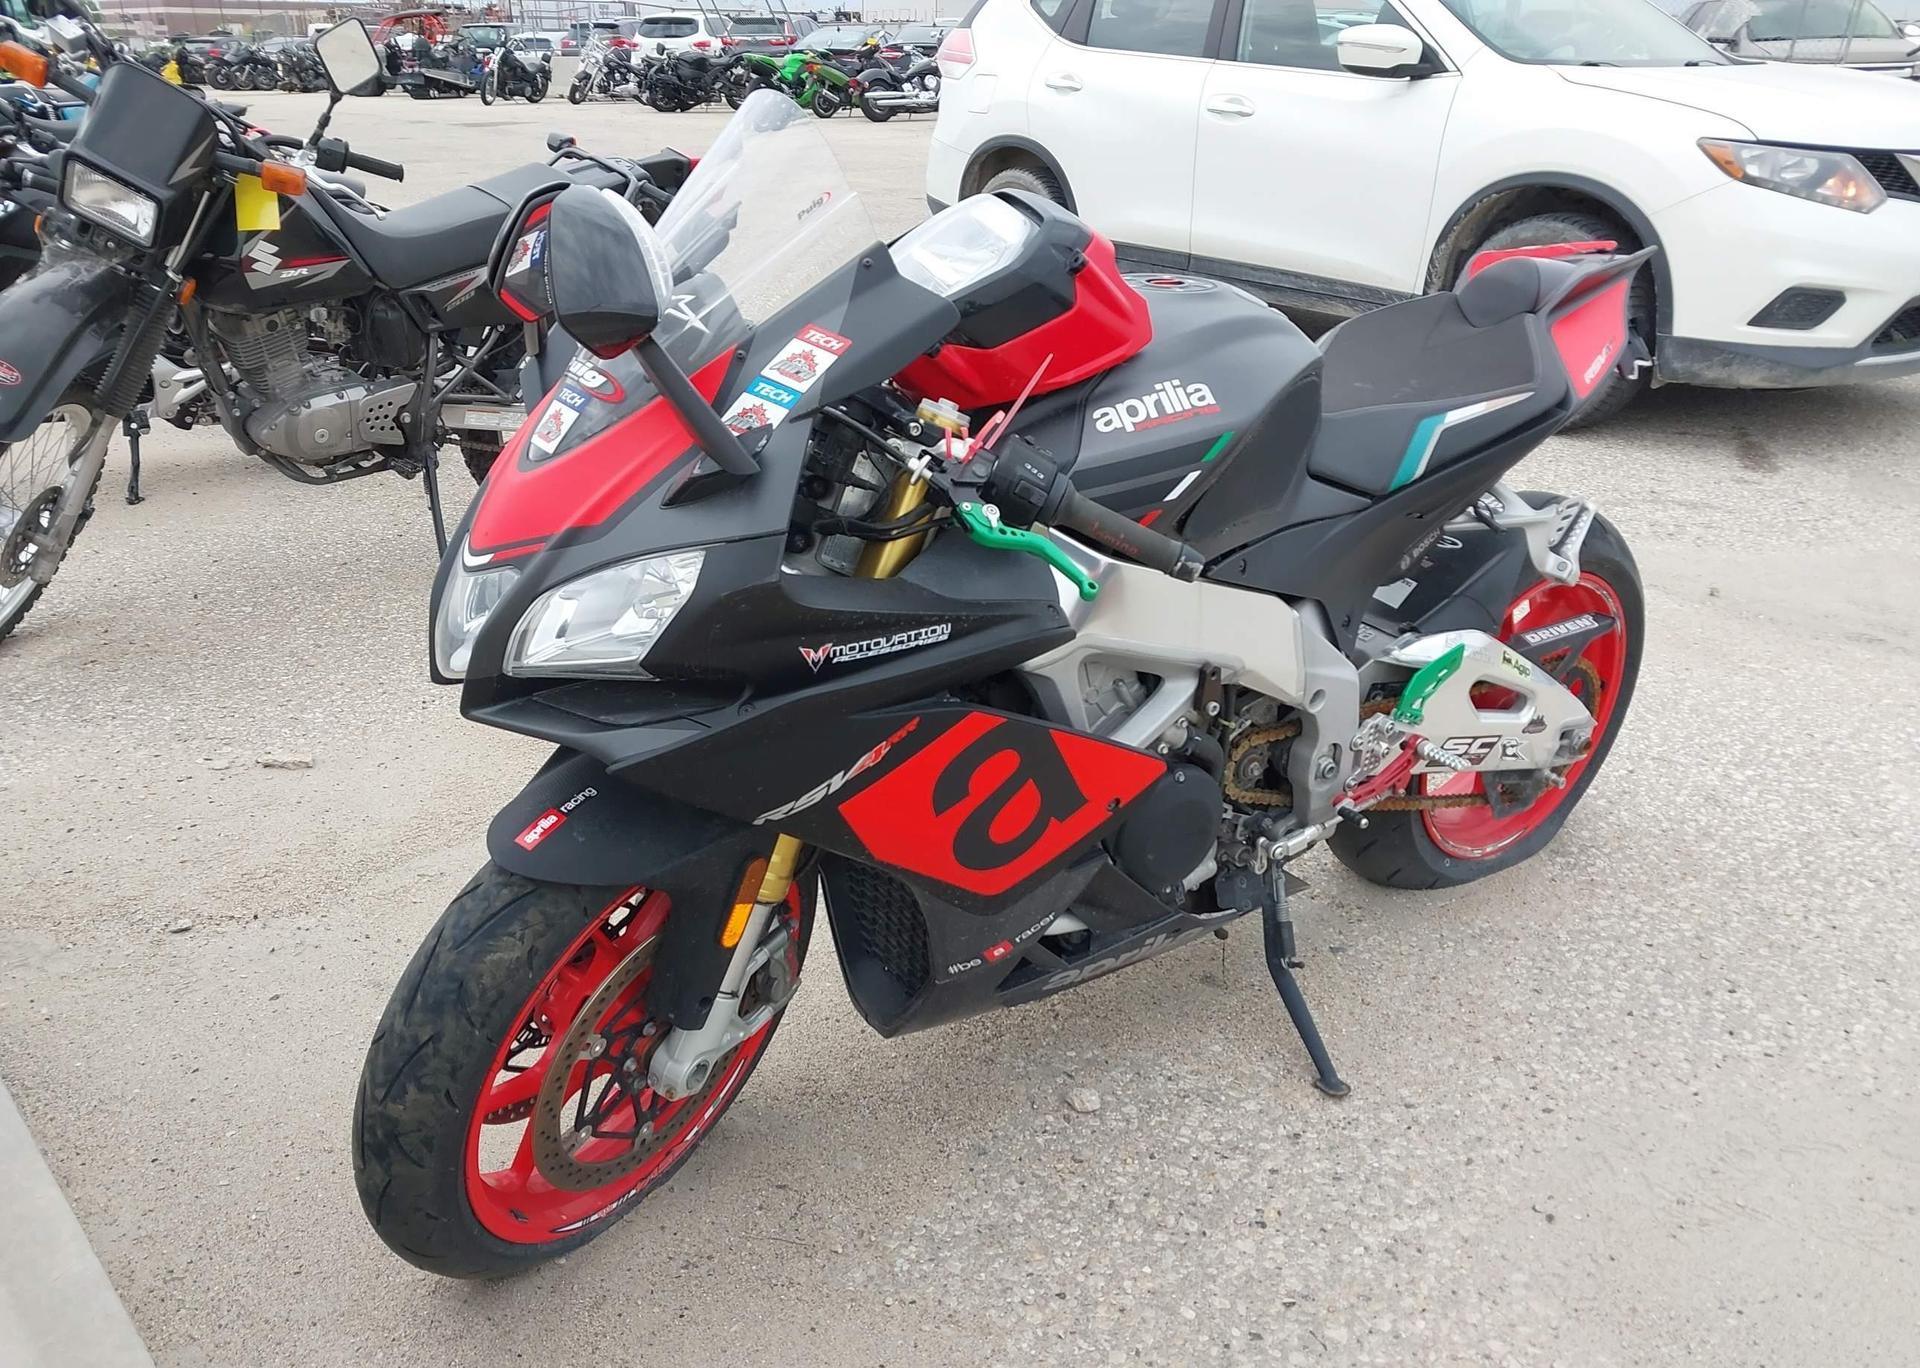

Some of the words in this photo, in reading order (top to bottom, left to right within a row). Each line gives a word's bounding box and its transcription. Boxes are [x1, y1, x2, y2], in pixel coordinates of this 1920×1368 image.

[797, 196, 824, 220] Puig
[280, 268, 309, 278] DR
[804, 329, 845, 350] TECH
[567, 360, 608, 388] uig
[559, 387, 586, 407] TECH
[754, 381, 795, 404] TECH
[1092, 379, 1217, 433] aprilia
[1412, 527, 1441, 558] BOSCH
[830, 623, 951, 658] MOTOVATION
[1524, 615, 1593, 644] DRIVEN
[832, 633, 950, 664] ACCESSORIES
[523, 814, 559, 844] aprilia
[560, 787, 598, 813] racing
[1015, 911, 1055, 943] racer
